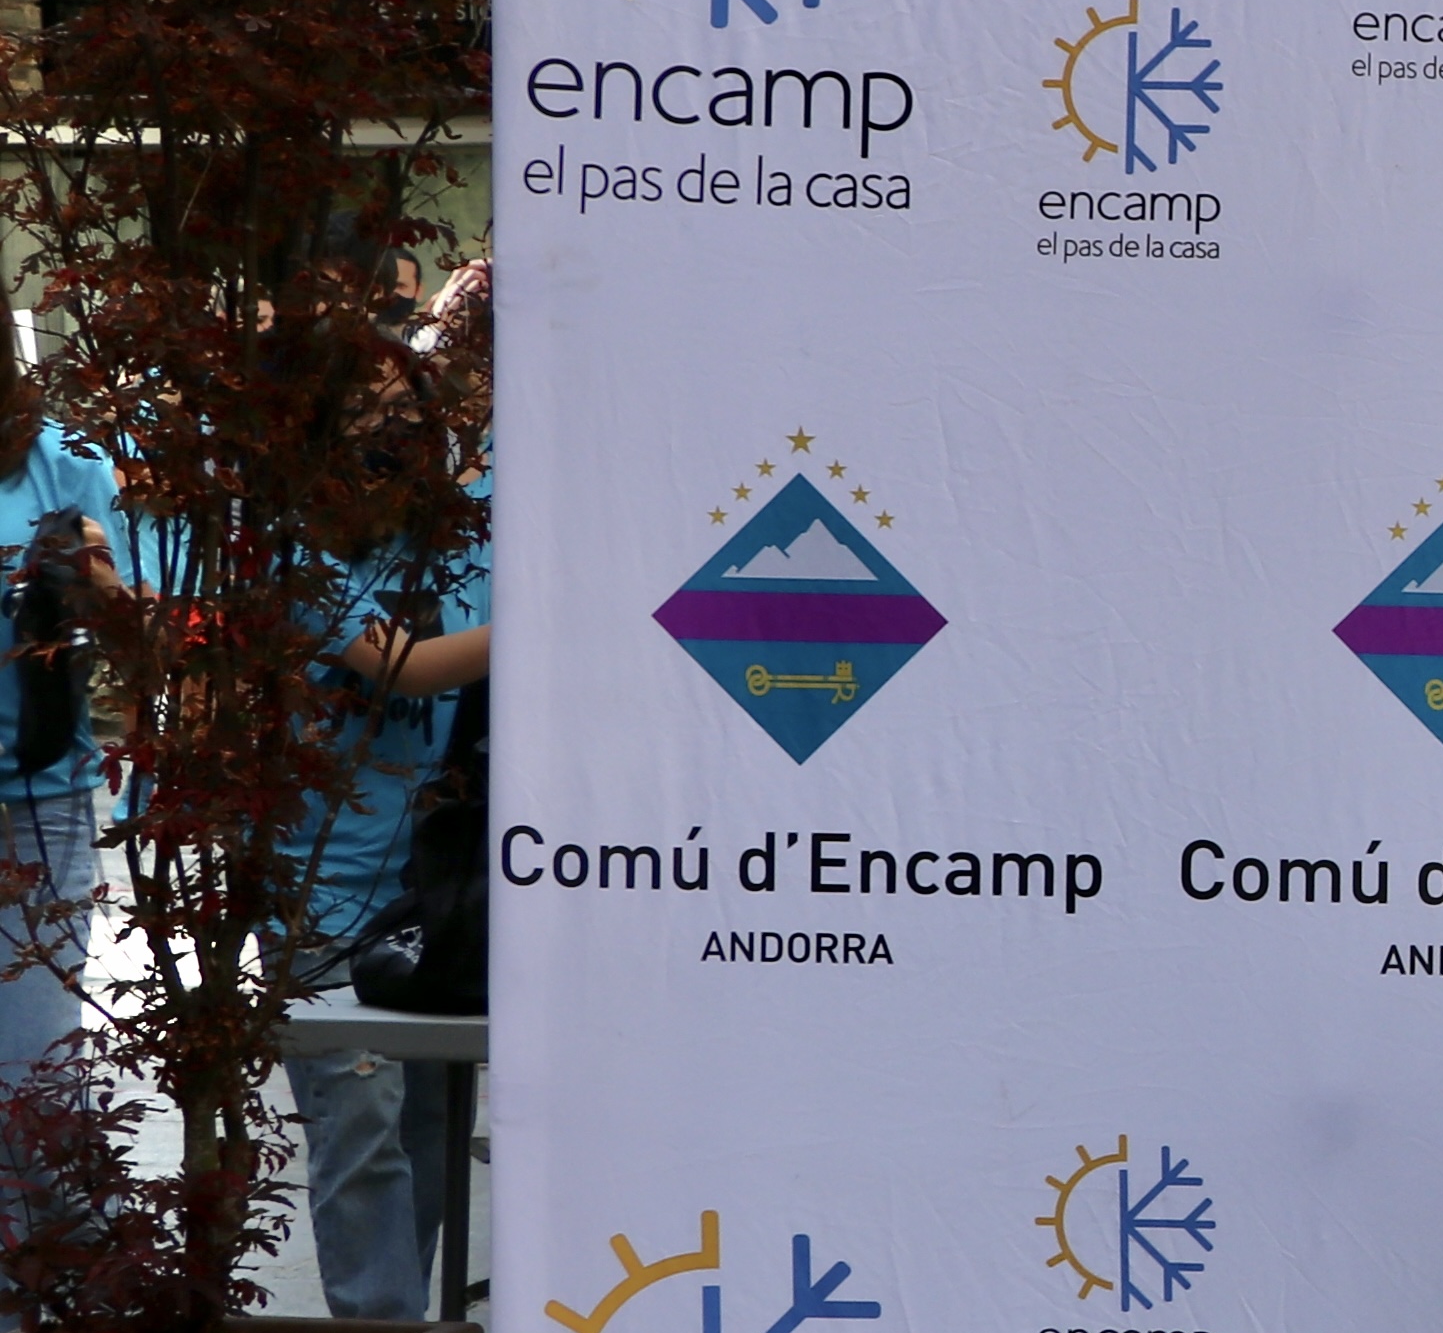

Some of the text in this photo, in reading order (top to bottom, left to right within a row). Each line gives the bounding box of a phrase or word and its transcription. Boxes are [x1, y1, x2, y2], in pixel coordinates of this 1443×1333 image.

[1351, 52, 1372, 77] el
[1378, 60, 1418, 85] pas
[527, 58, 914, 160] encamp
[523, 144, 911, 215] el pas de la casa
[1038, 190, 1221, 236] encamp
[1036, 231, 1220, 264] el pas de la casa
[501, 824, 1103, 915] Comú d'Encamp
[1180, 839, 1389, 905] Comú
[700, 931, 894, 965] ANDORRA
